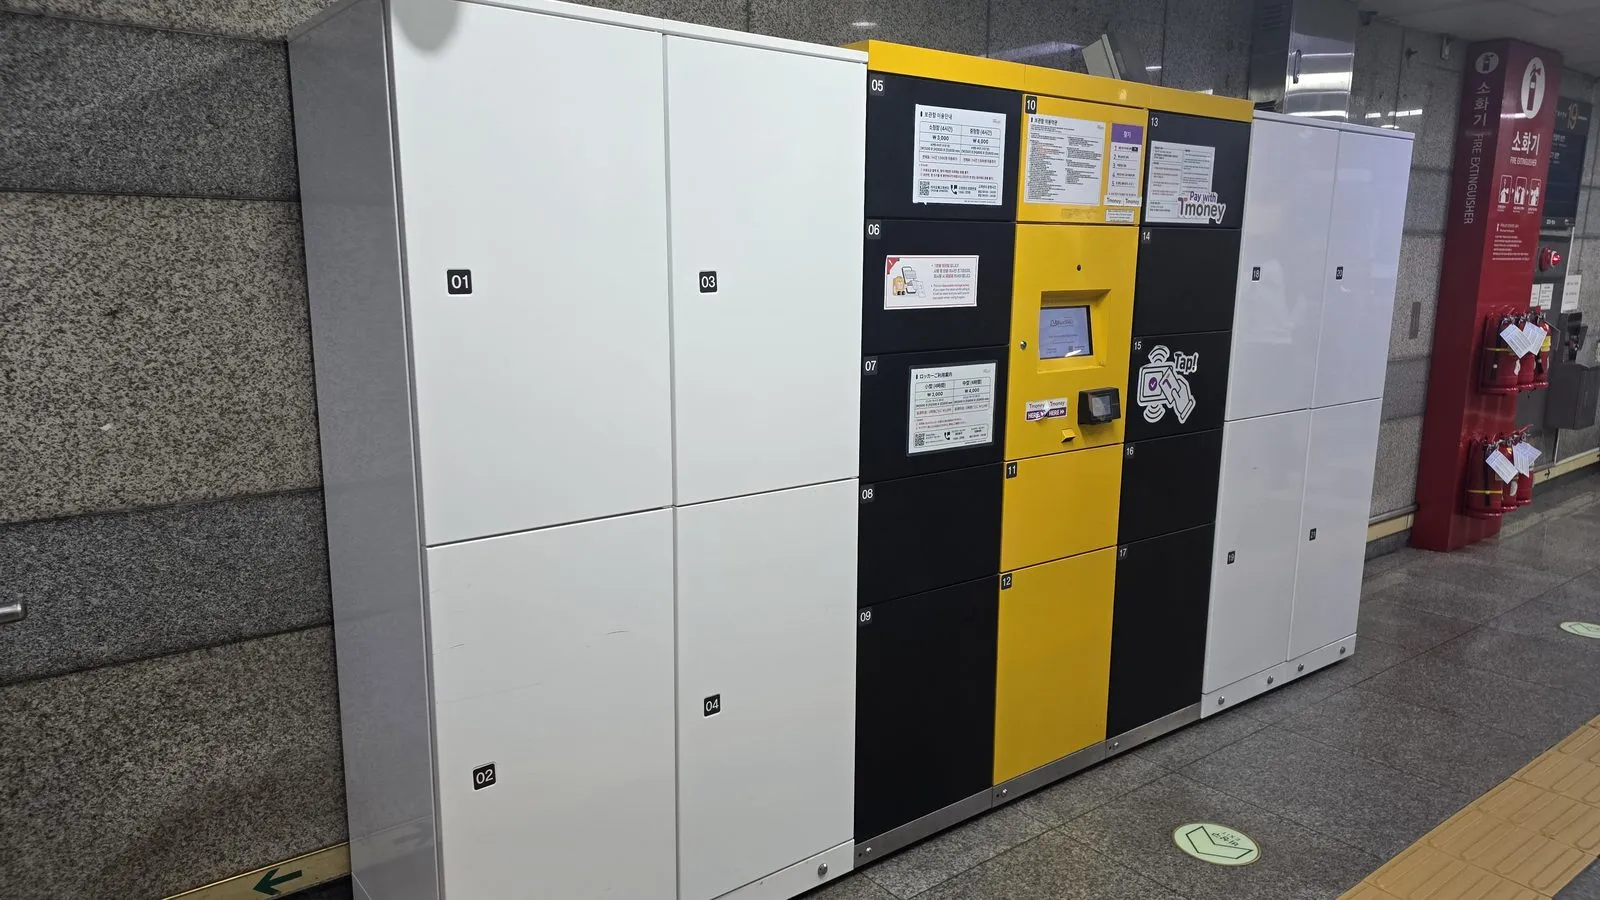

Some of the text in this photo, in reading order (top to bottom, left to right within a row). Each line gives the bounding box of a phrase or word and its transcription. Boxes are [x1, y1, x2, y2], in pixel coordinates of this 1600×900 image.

[872, 80, 884, 92] 05
[1026, 99, 1036, 111] 10
[1473, 82, 1491, 126] 소화기
[1151, 117, 1159, 127] 13
[1511, 131, 1541, 156] 소화기
[1464, 133, 1484, 224] FIRE EXTINGUISHER
[1190, 191, 1217, 203] Pay with
[1177, 197, 1226, 222] Tmoney
[868, 223, 880, 236] 06
[1143, 231, 1151, 241] 14
[451, 275, 469, 289] 01
[701, 275, 716, 288] 03
[1134, 341, 1142, 350] 15
[865, 360, 877, 371] 07
[1175, 353, 1197, 372] Tap!
[1126, 446, 1134, 456] 16
[1008, 465, 1016, 475] 11
[862, 488, 873, 500] 08
[1120, 548, 1127, 557] 17
[1003, 576, 1012, 586] 12
[860, 611, 871, 622] 09
[705, 699, 718, 712] 04
[476, 768, 494, 784] 02
